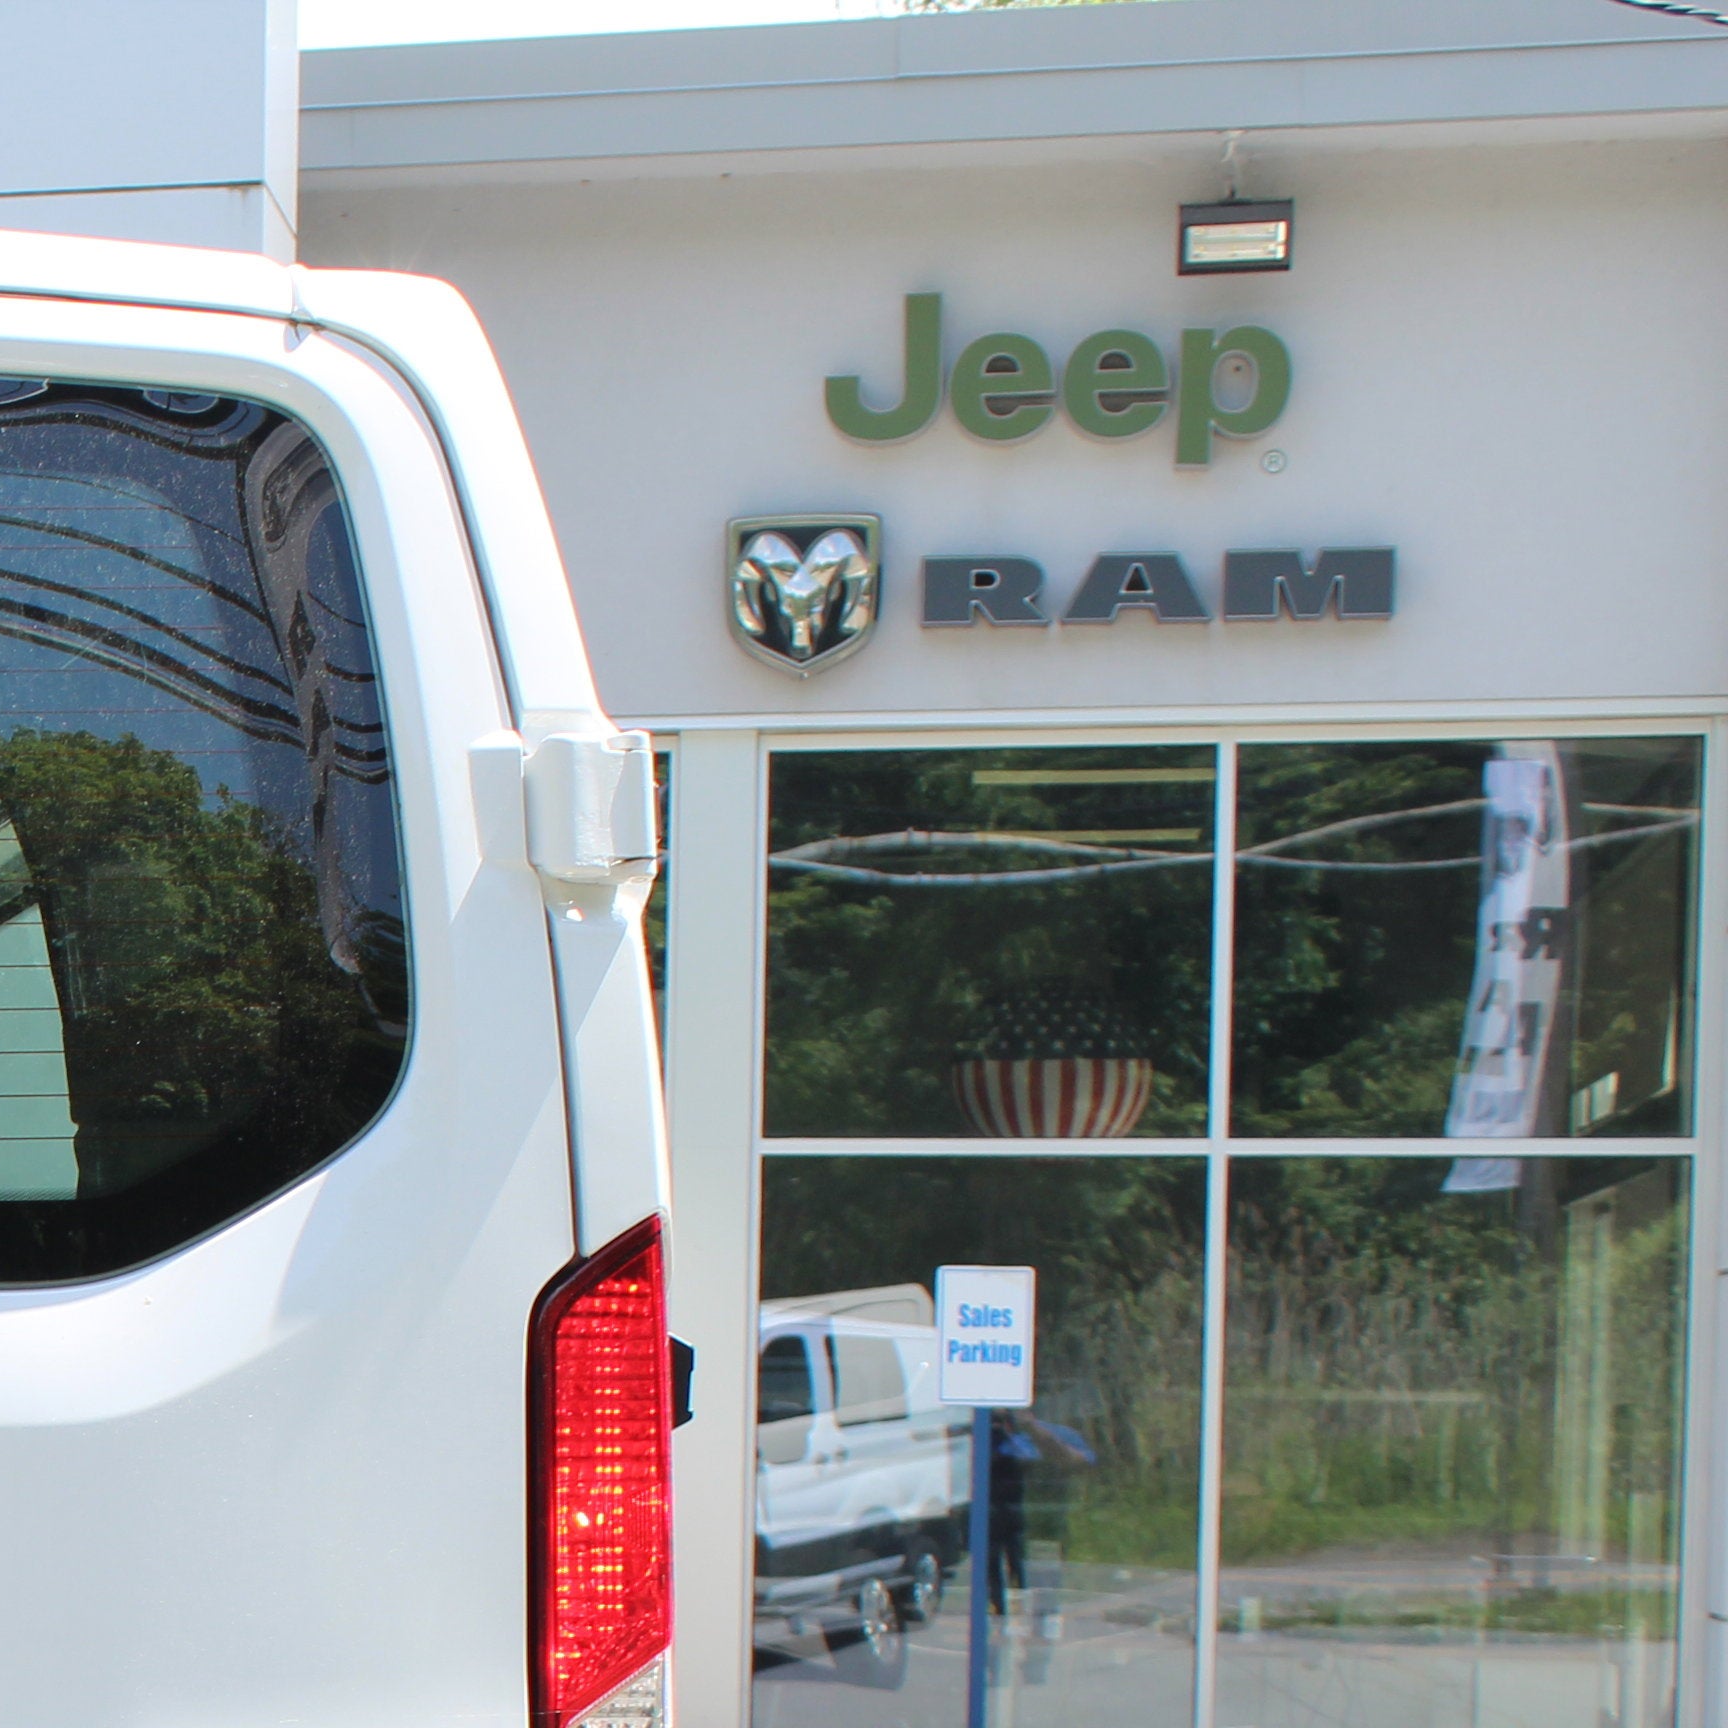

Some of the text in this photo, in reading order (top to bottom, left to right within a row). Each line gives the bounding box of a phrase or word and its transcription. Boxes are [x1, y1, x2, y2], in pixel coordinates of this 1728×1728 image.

[824, 291, 1294, 472] Jeep
[920, 546, 1396, 628] RAM
[958, 1303, 1014, 1328] Sales
[948, 1338, 1023, 1367] Parking
